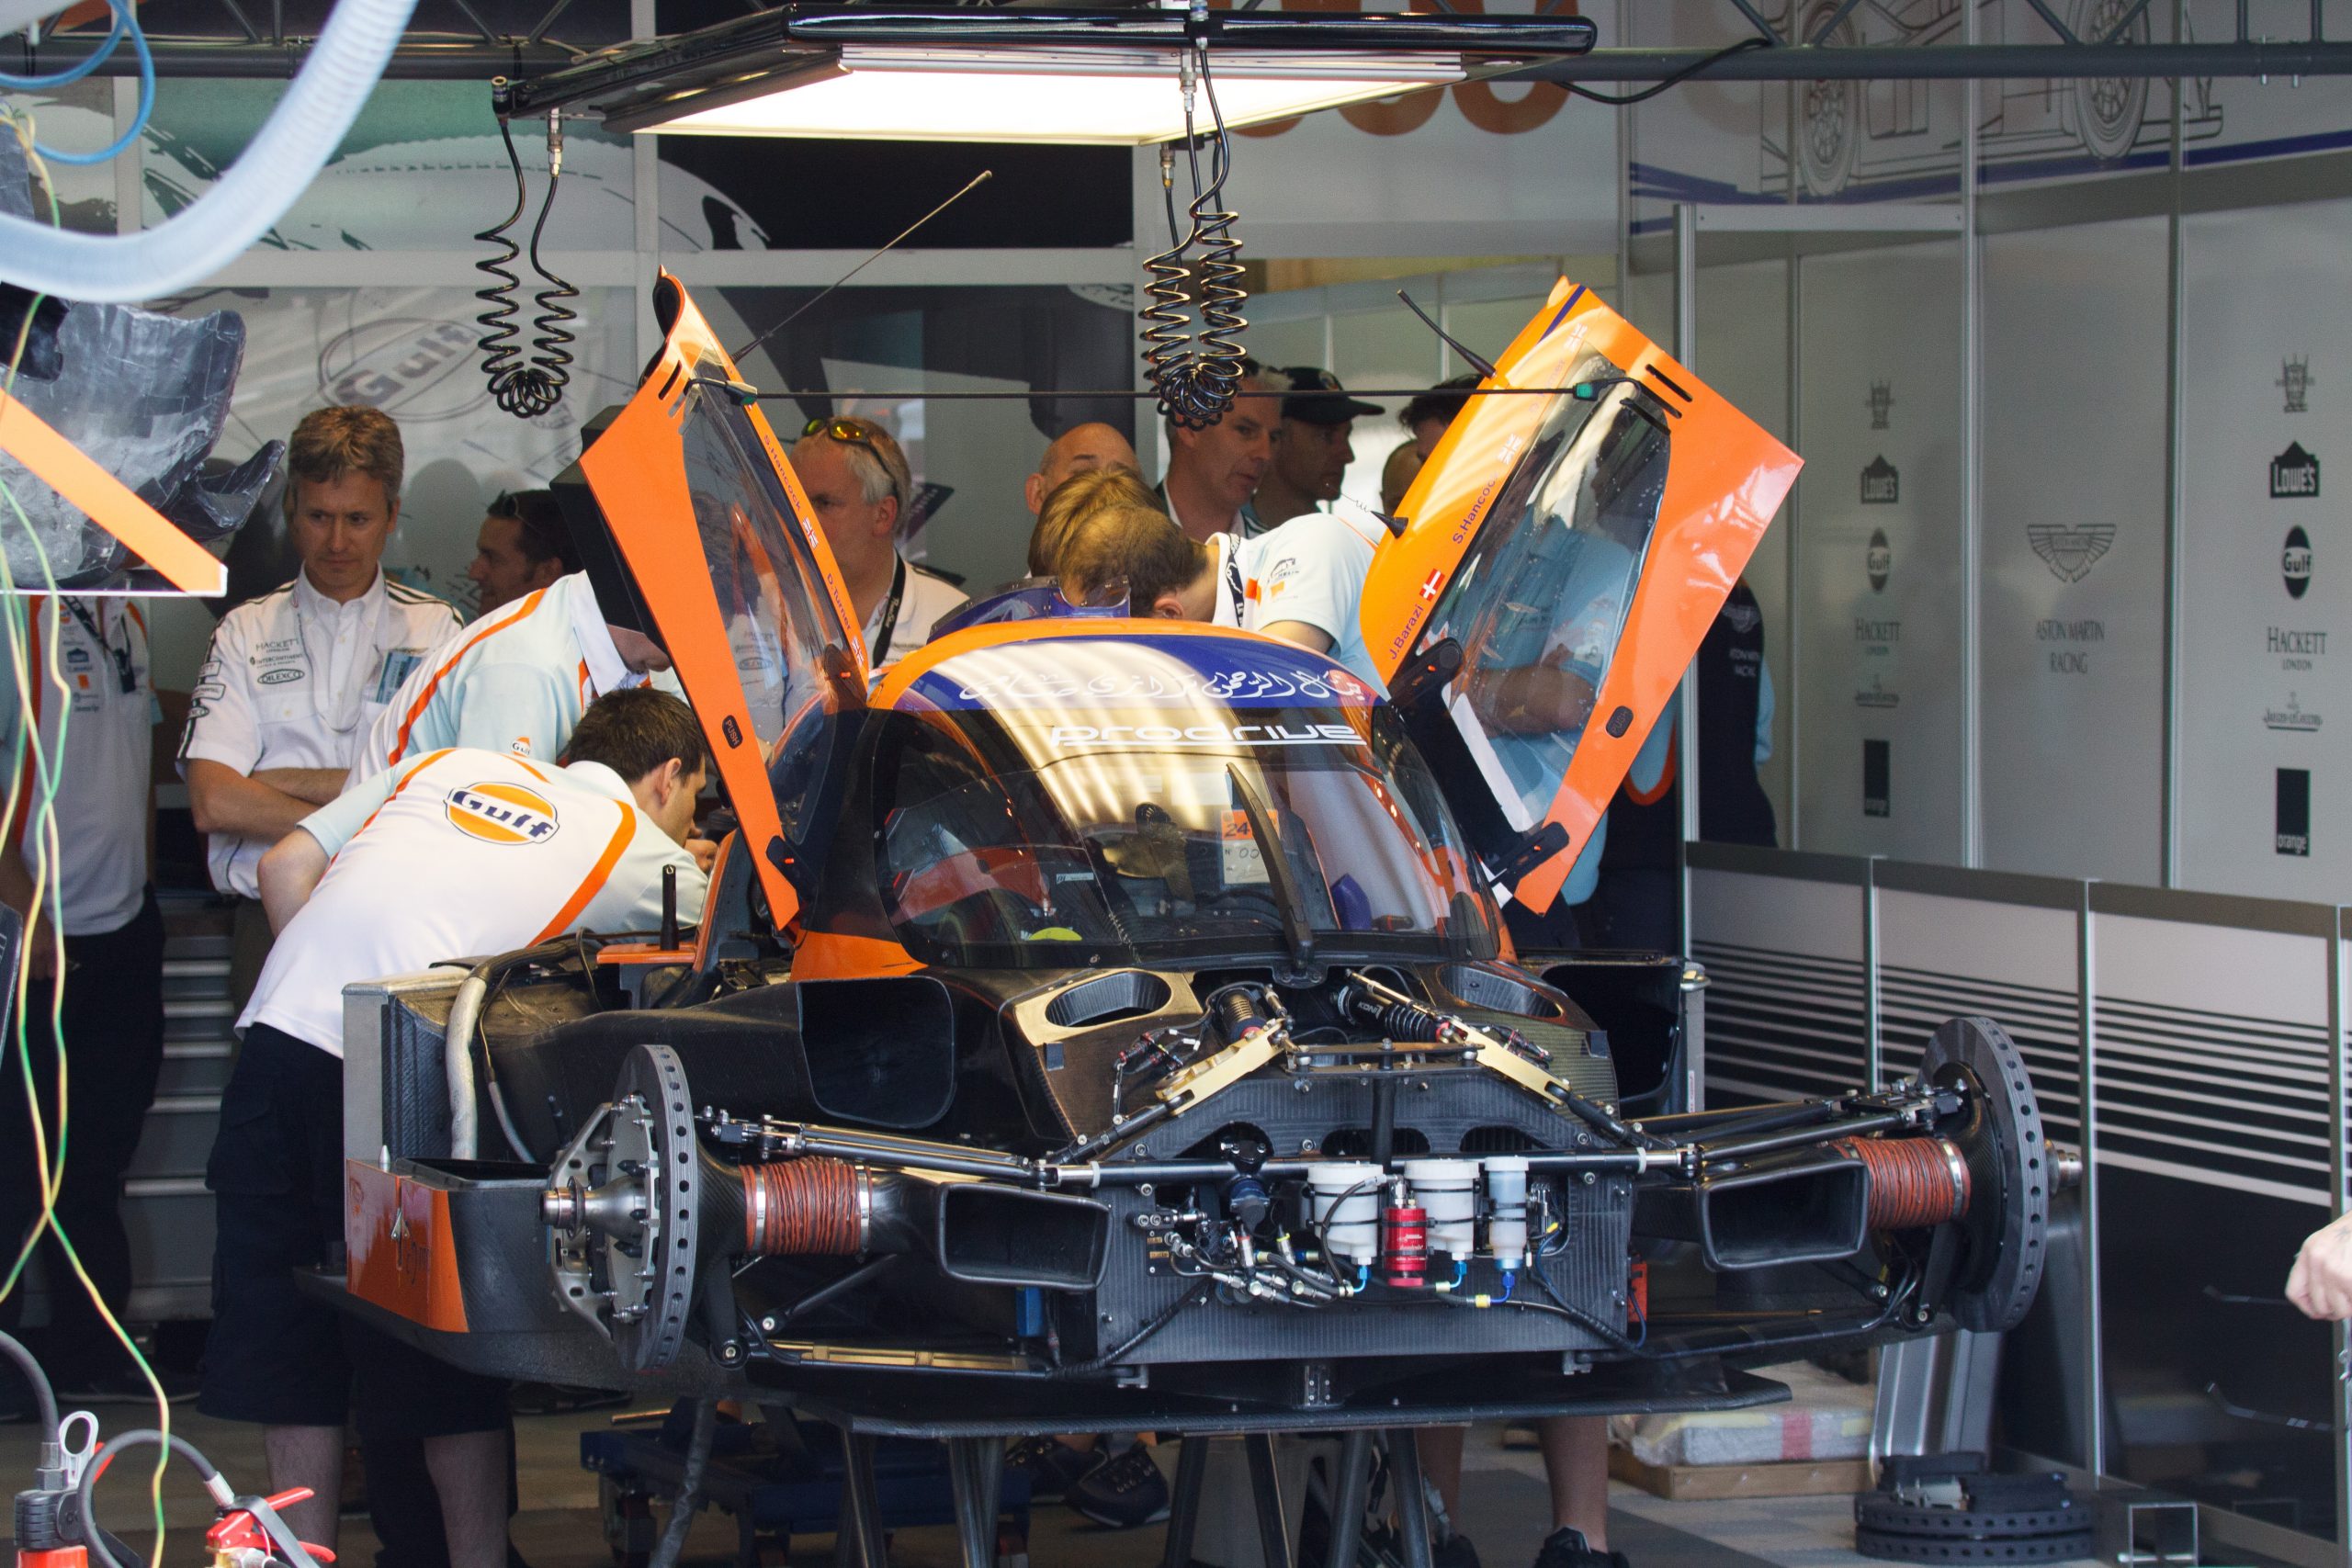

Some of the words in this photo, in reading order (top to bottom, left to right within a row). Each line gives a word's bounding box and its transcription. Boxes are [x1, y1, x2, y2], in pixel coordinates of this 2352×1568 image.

[334, 325, 477, 405] Gulf
[764, 434, 800, 511] S.Hancock
[2275, 463, 2315, 493] LOWE'S
[1453, 472, 1498, 544] S.Hancoc
[2283, 552, 2311, 572] Gulf
[827, 573, 851, 629] D.Turner
[1389, 604, 1424, 660] J.Barazi
[1855, 617, 1901, 641] HACKETT
[2267, 626, 2327, 654] HACKETT
[1050, 724, 1363, 746] prodrive
[452, 790, 553, 838] Gulf
